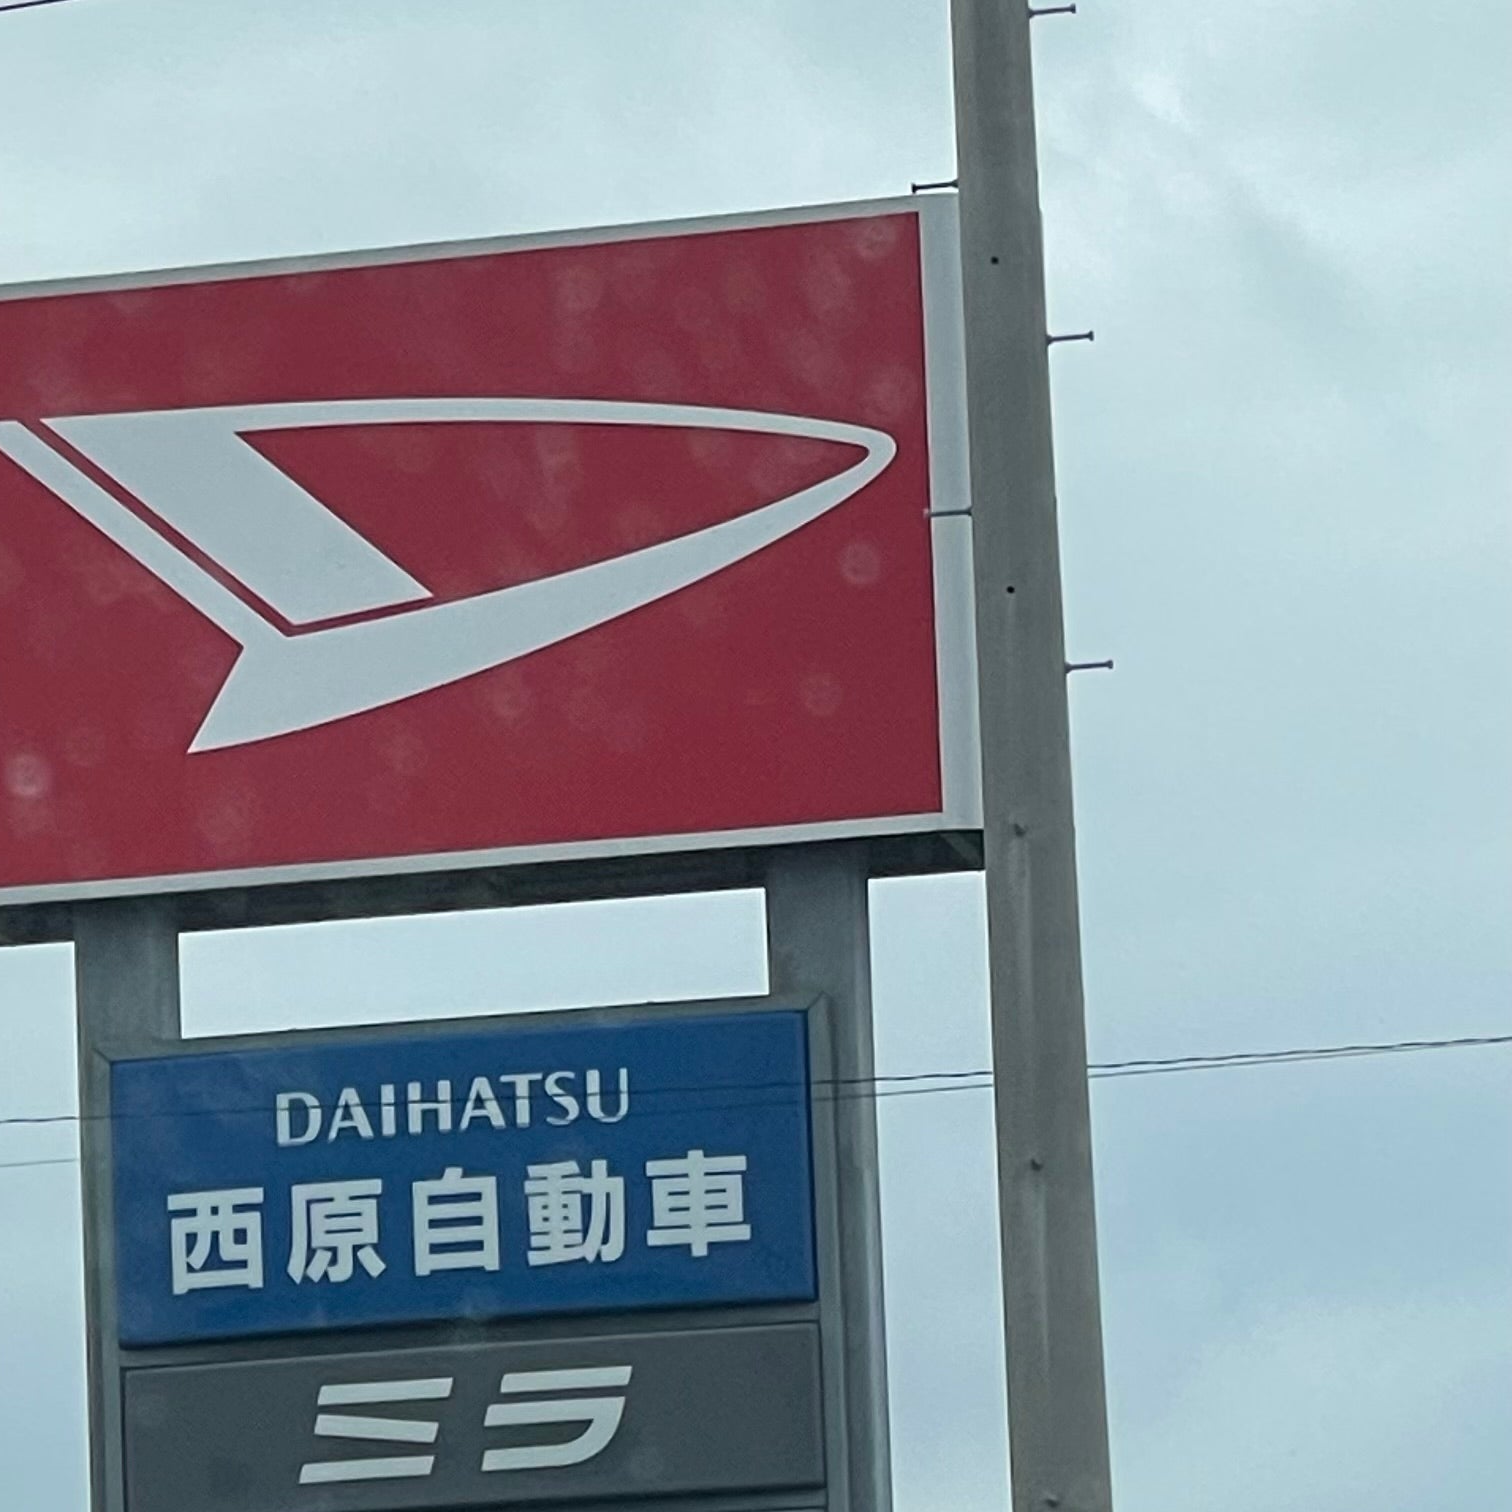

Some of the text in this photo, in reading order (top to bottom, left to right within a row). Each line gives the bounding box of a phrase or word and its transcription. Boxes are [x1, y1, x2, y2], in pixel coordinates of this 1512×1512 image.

[275, 1067, 630, 1147] DAIHATSU
[167, 1149, 752, 1295] 西原自動車
[298, 1365, 633, 1485] ミラ
